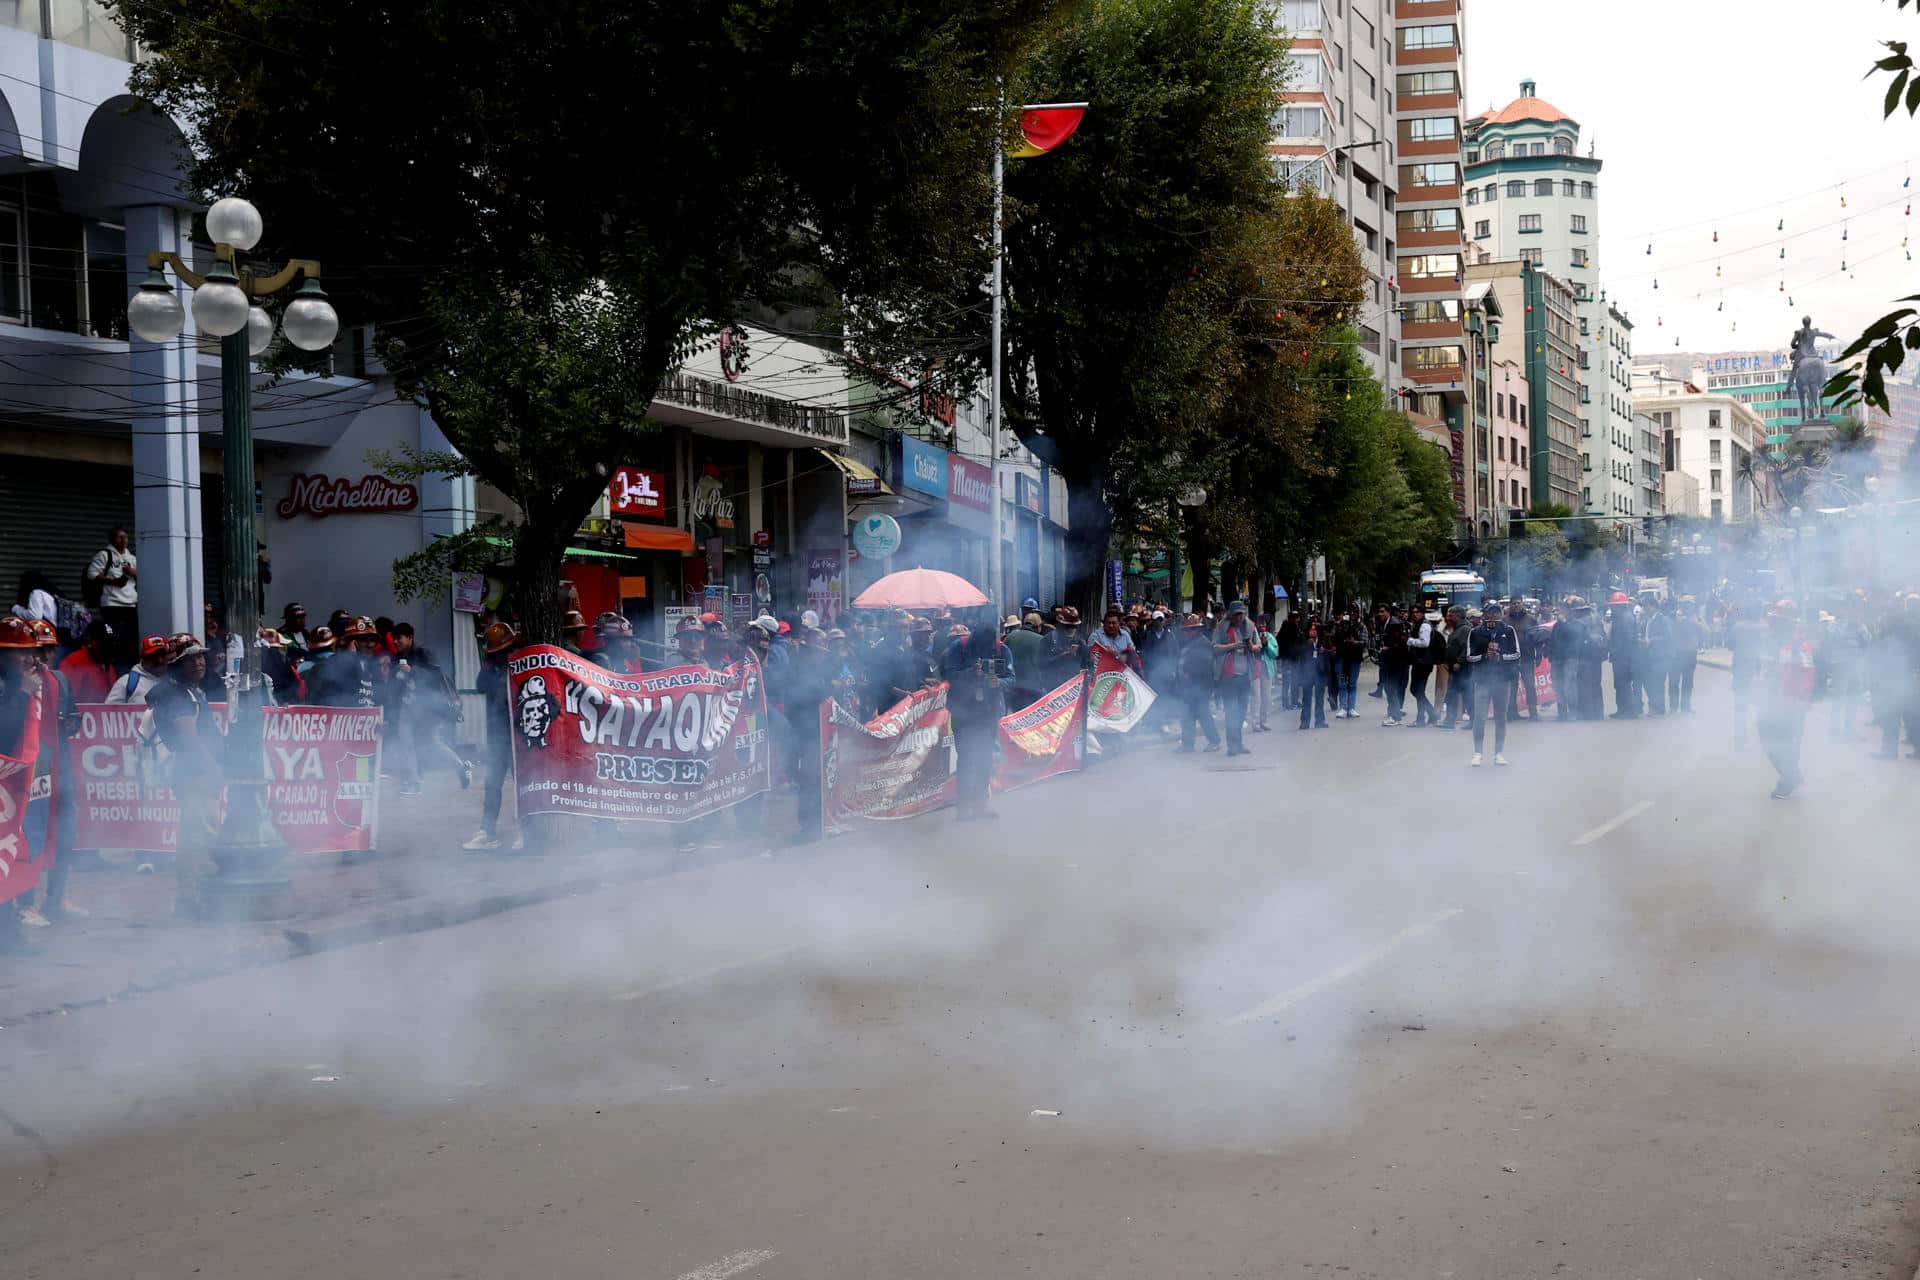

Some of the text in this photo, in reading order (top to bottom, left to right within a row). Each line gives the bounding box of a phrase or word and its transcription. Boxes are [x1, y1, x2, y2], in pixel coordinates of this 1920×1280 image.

[1707, 355, 1761, 371] LOTERIA
[952, 463, 992, 503] Manac
[281, 476, 412, 514] Michelline
[508, 653, 589, 679] SINDICATO
[591, 670, 640, 692] MIXTO
[586, 785, 598, 795] de
[664, 791, 679, 801] de
[90, 806, 134, 822] PROV.
[551, 794, 597, 809] Provincia
[646, 802, 663, 814] del
